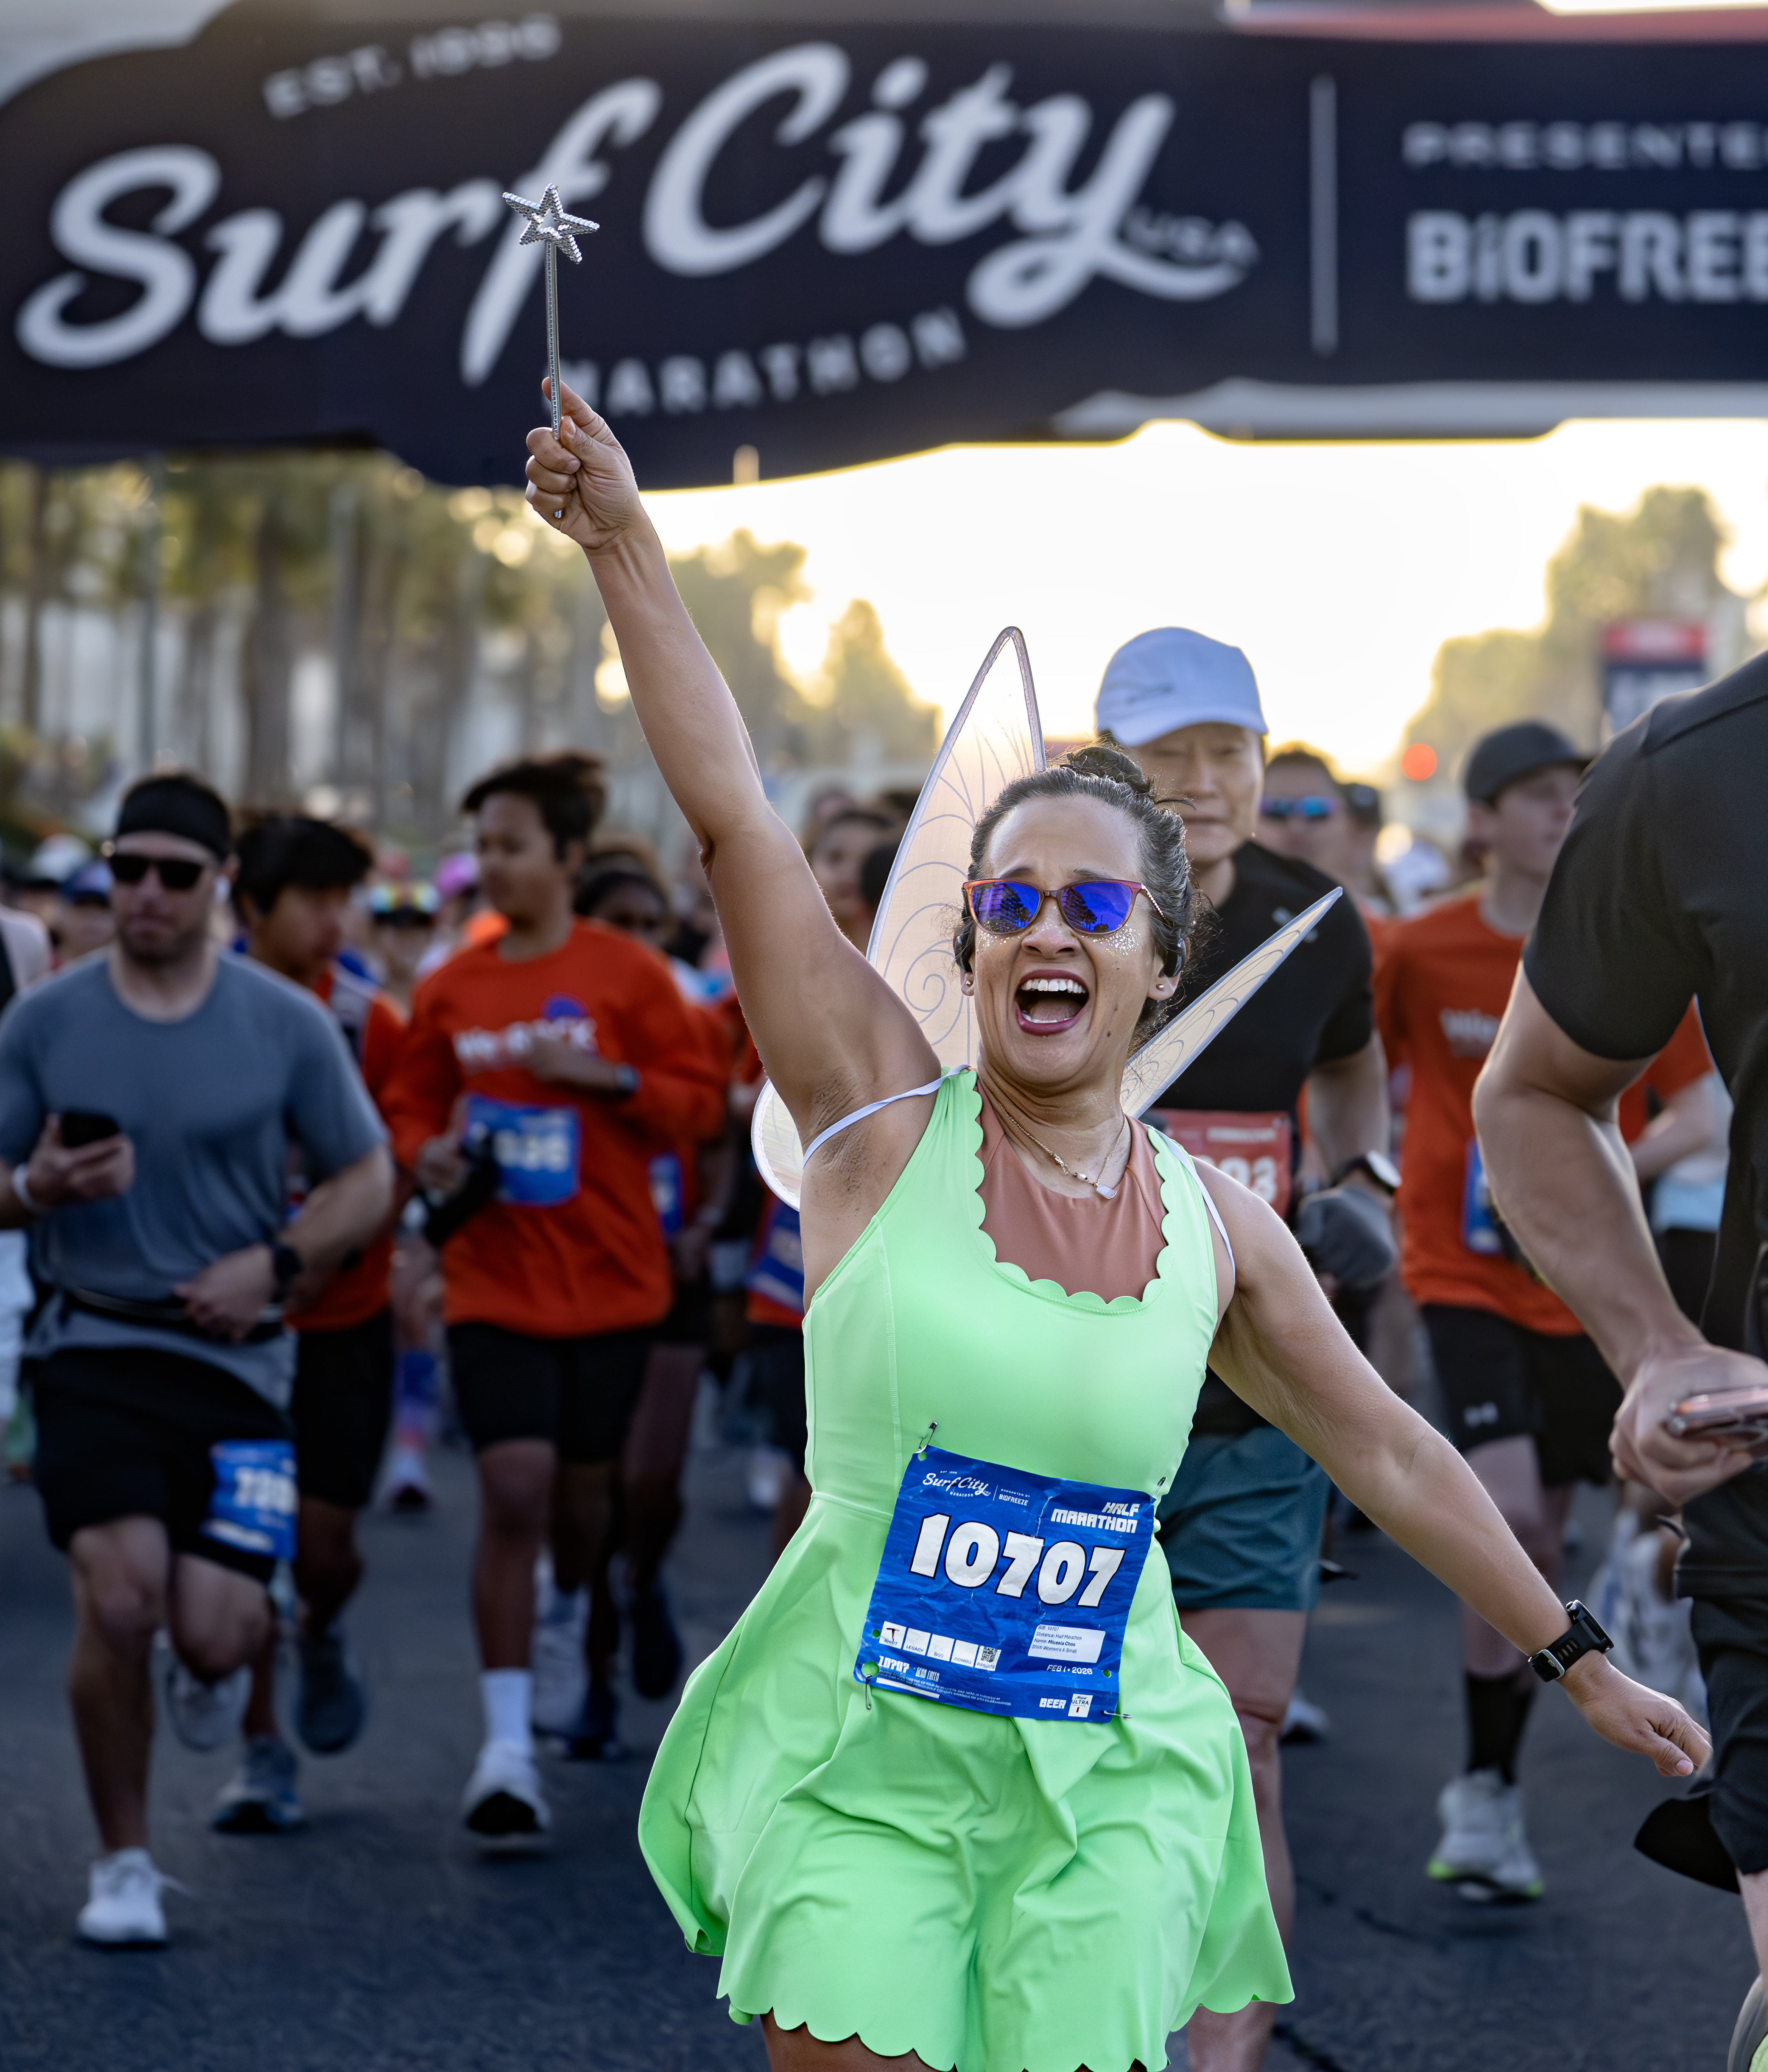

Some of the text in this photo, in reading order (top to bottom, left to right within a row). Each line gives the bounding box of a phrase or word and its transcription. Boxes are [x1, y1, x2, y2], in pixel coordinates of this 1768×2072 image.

[15, 44, 1248, 384] Surf City
[923, 1473, 990, 1496] Surf City
[1101, 1502, 1140, 1517] HALF
[1051, 1508, 1138, 1533] MARATHON
[909, 1513, 1126, 1608] 10707
[879, 1655, 910, 1673] 10707
[1072, 1667, 1093, 1675] 2026
[1039, 1698, 1067, 1709] BEER
